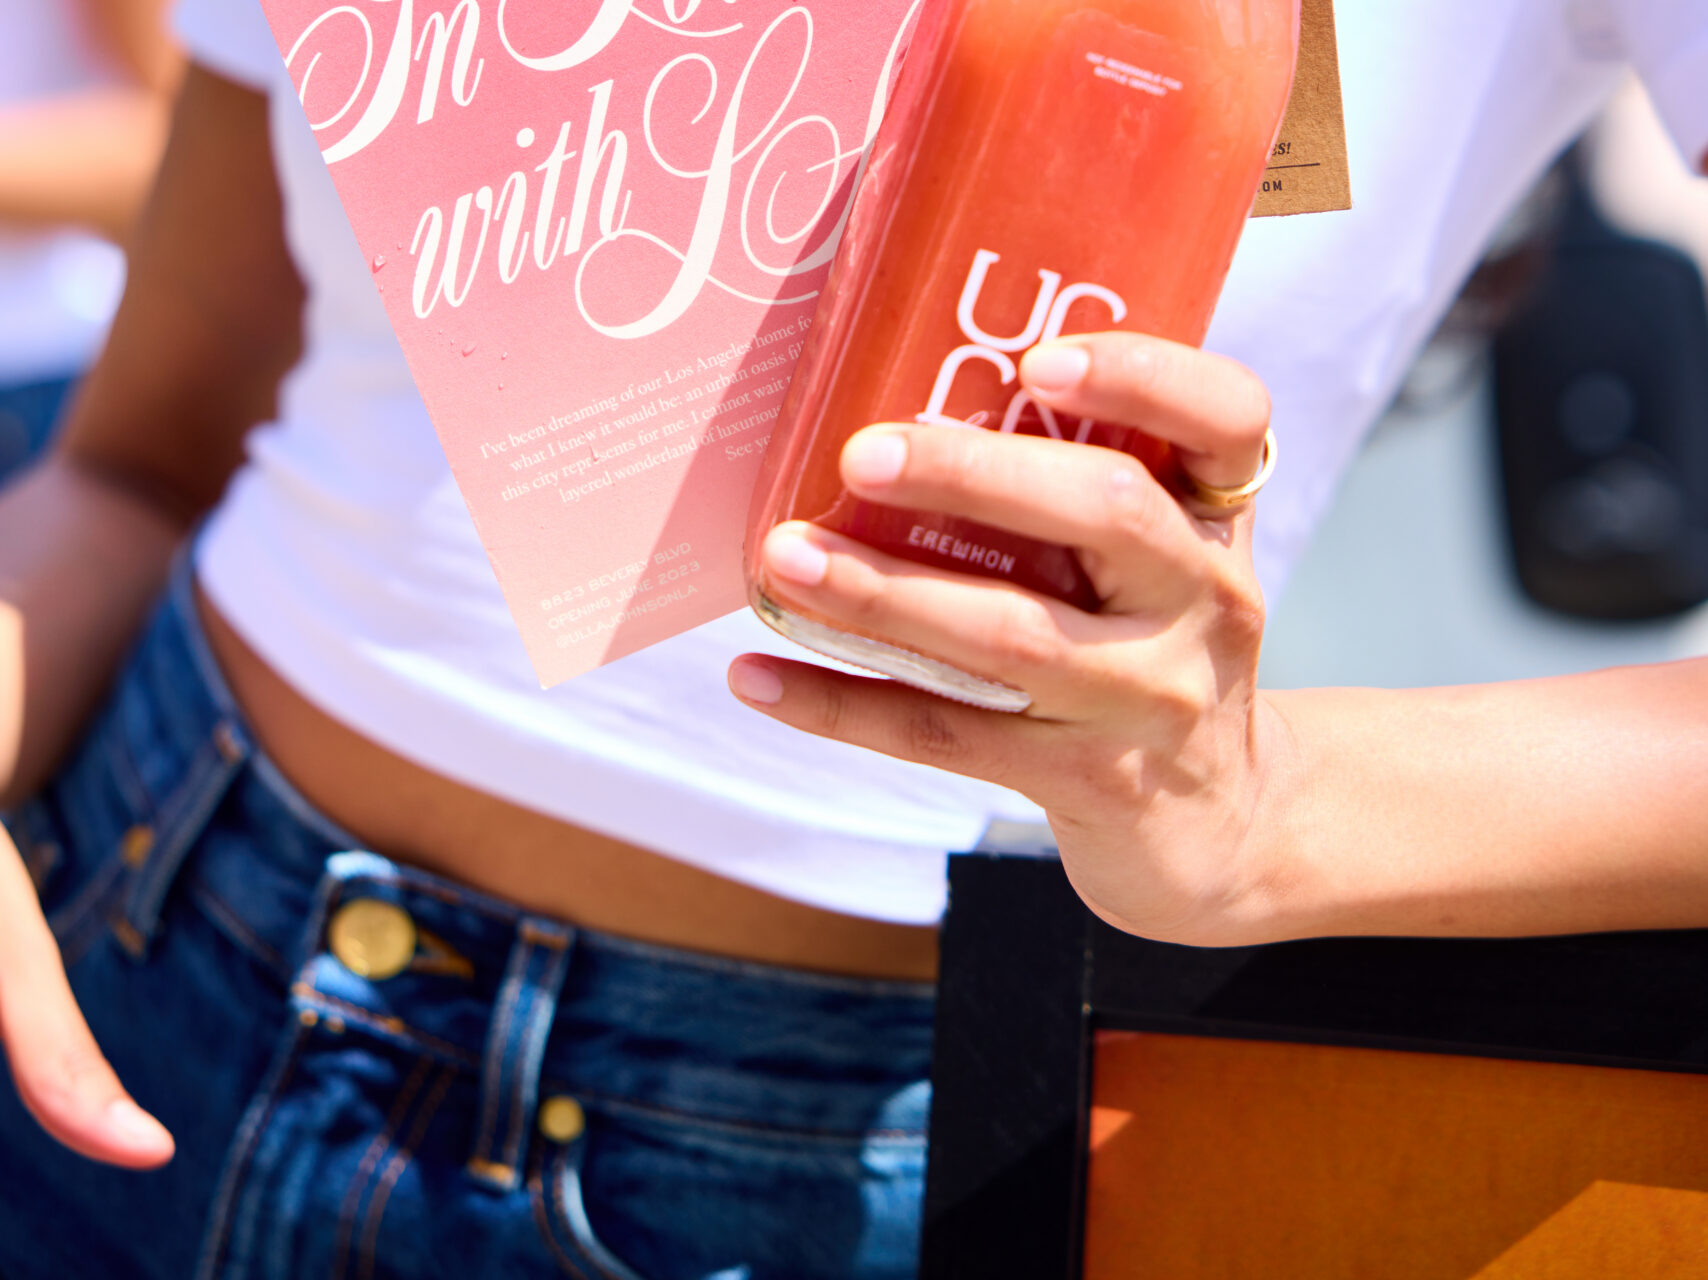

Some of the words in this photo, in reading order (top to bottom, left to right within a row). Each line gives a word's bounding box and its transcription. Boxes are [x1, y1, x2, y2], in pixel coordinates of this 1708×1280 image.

[410, 78, 632, 320] with
[480, 442, 507, 459] I've
[508, 425, 547, 448] been
[548, 397, 619, 432] dreaming
[620, 383, 635, 402] of
[637, 377, 663, 395] our
[664, 365, 694, 384] Los
[697, 342, 753, 373] Angeles
[753, 323, 796, 348] home
[510, 451, 547, 471] what
[547, 443, 556, 457] I
[558, 429, 598, 453] knew
[598, 421, 612, 436] it
[613, 401, 658, 430] would
[658, 395, 682, 412] be:
[685, 387, 703, 402] an
[705, 368, 749, 393] urban
[751, 351, 787, 376] oasis
[501, 480, 531, 502] this
[532, 470, 559, 489] city
[638, 429, 660, 446] for
[661, 419, 690, 436] me.
[690, 410, 699, 424] I
[701, 392, 752, 420] cannot
[752, 377, 785, 399] wait
[559, 472, 614, 504] layered
[614, 435, 698, 480] wonderland
[700, 427, 716, 446] of
[725, 442, 753, 461] See
[540, 585, 585, 611] 8823
[588, 560, 649, 592] BEVERLY
[653, 542, 691, 565] BLVD
[908, 525, 1016, 574] EREWHON
[547, 596, 611, 629] OPENING
[615, 578, 654, 603] JUNE
[657, 560, 701, 585] 2023
[555, 584, 699, 649] @ULLAJOHNSONLA
